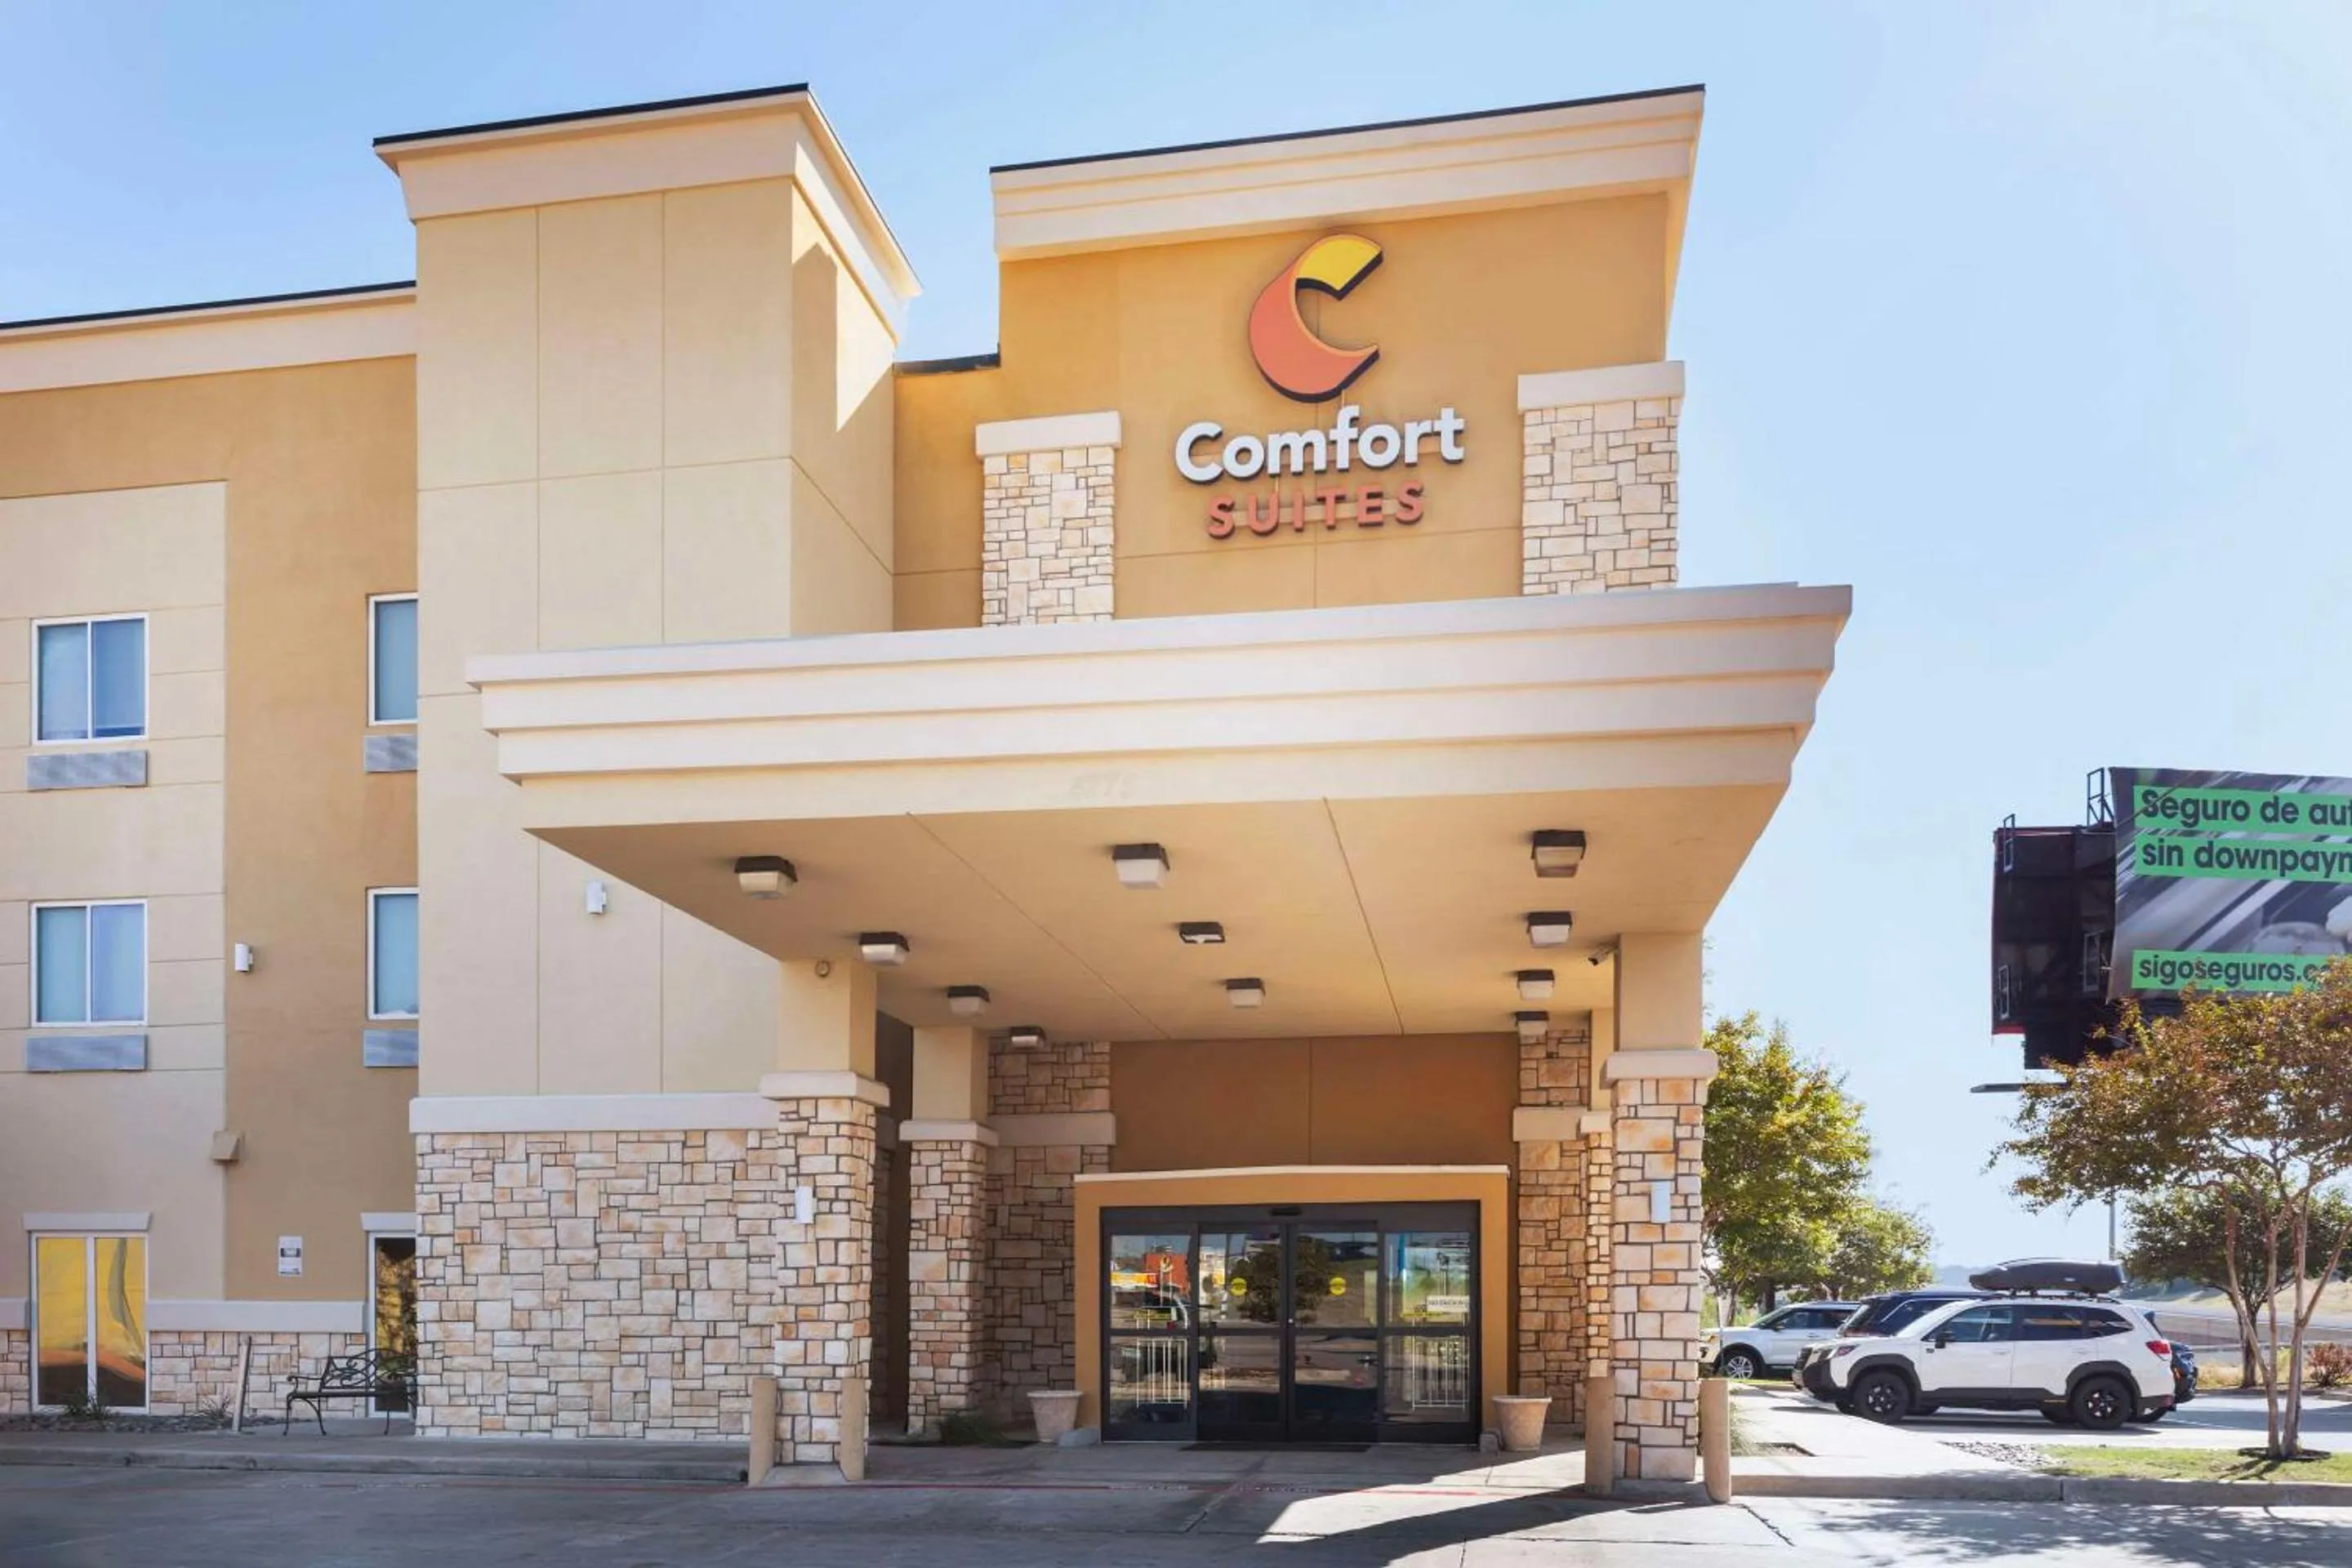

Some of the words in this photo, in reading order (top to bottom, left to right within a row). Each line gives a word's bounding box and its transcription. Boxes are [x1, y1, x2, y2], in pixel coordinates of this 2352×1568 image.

[1174, 404, 1465, 483] Comfort
[1206, 479, 1424, 540] SUITES
[2141, 790, 2252, 828] Seguro
[2260, 795, 2300, 824] de
[2142, 838, 2184, 867] sin
